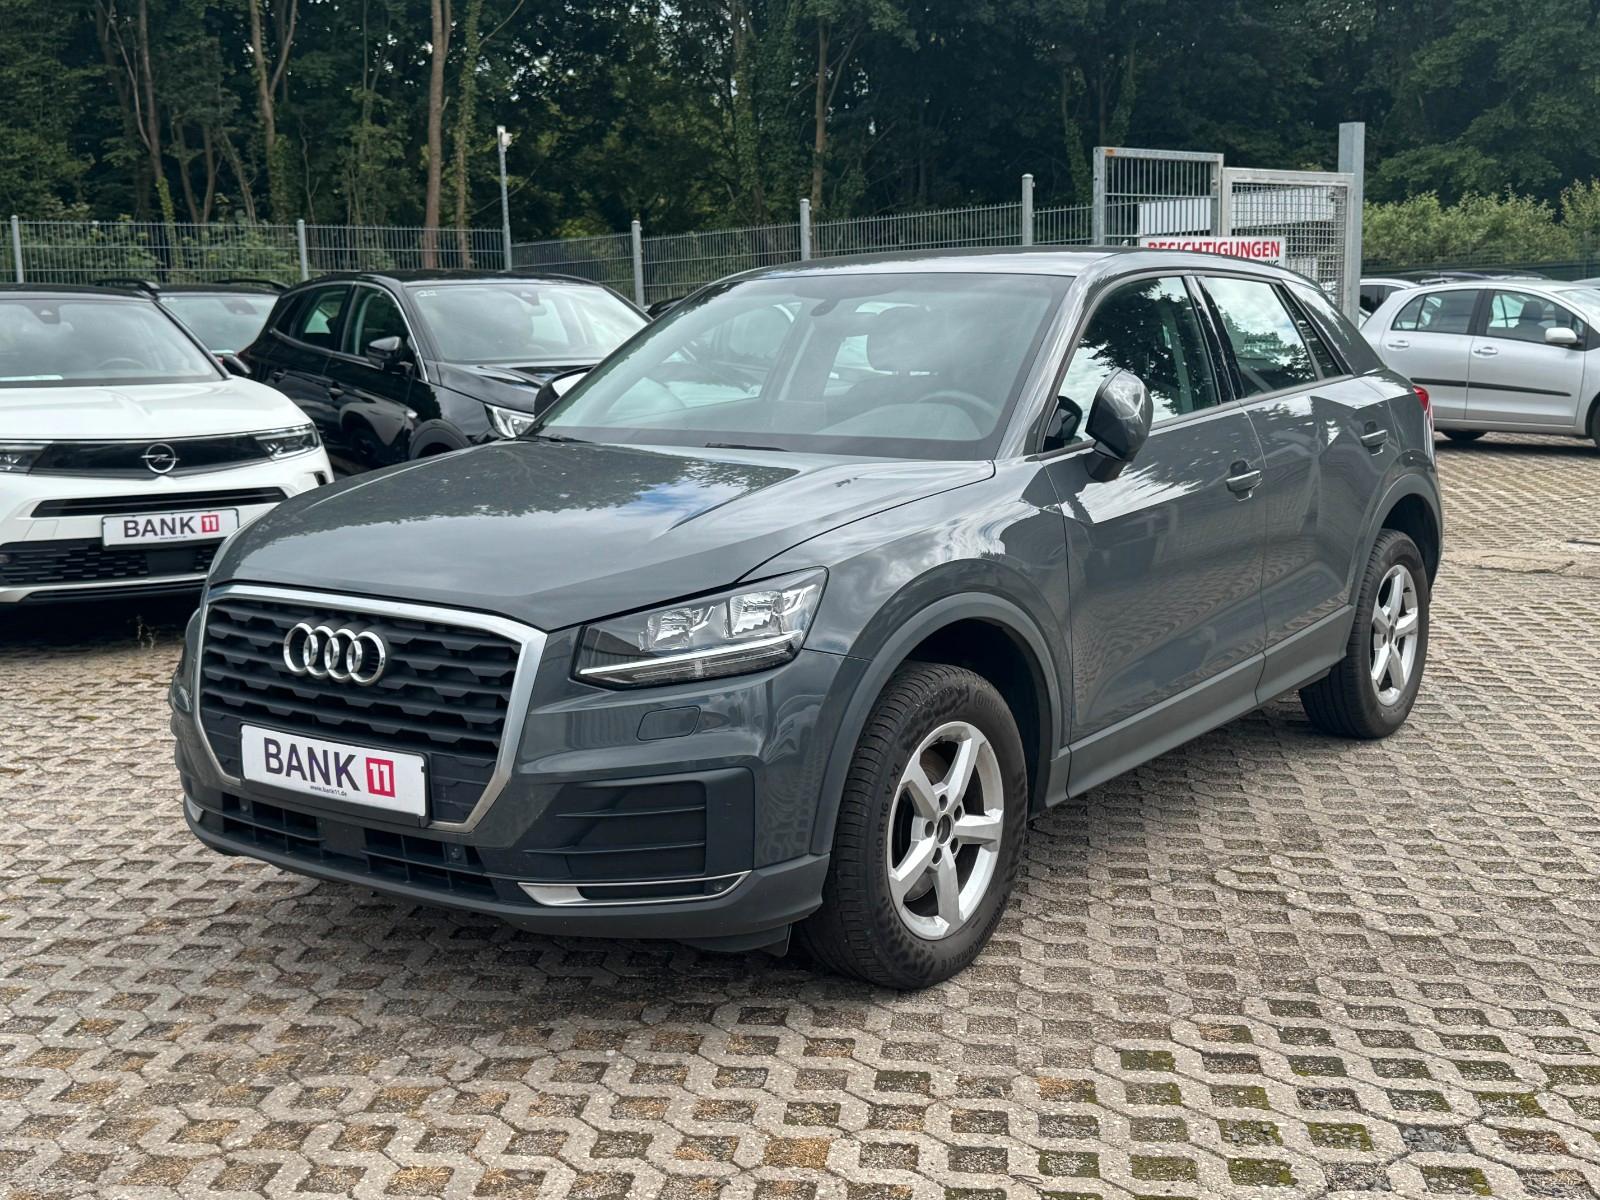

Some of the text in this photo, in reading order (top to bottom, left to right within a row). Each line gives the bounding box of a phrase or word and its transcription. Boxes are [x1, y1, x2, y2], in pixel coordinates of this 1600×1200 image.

[124, 516, 218, 538] BANK 11
[264, 737, 392, 793] BANK 11
